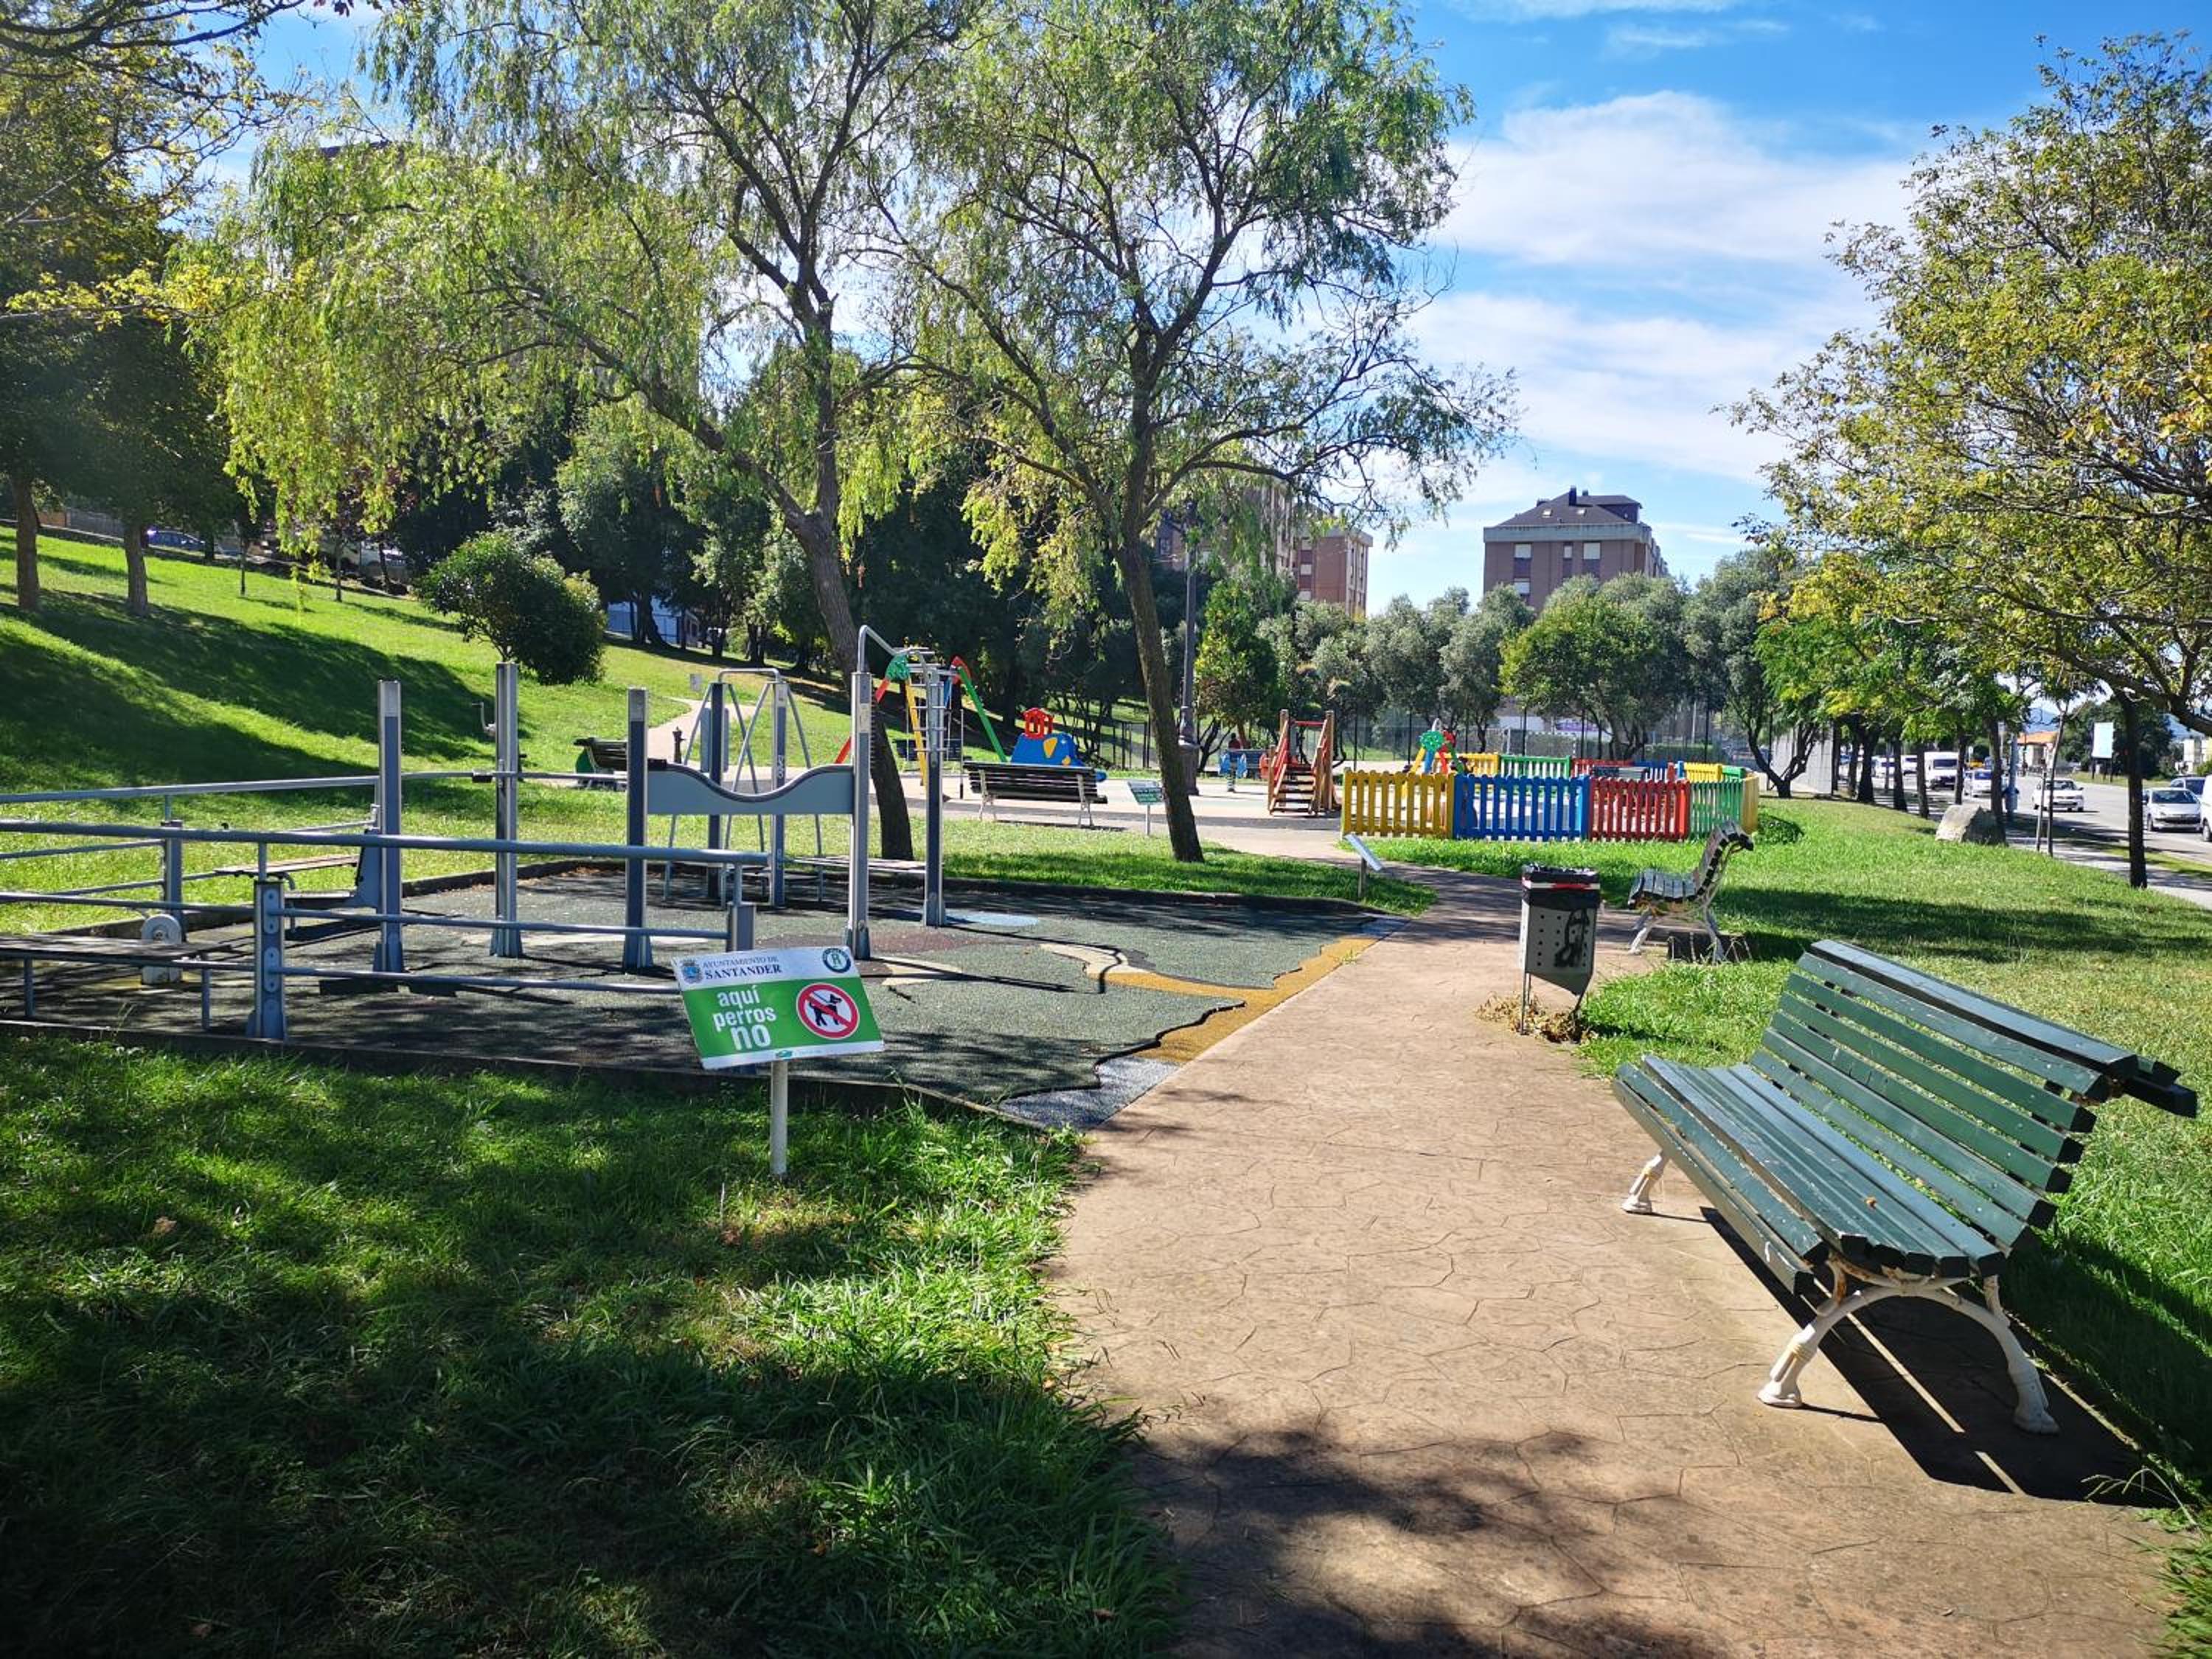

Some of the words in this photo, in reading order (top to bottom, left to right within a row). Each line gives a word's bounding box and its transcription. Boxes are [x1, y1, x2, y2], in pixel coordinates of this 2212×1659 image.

[705, 964, 782, 980] SANTANDER
[717, 984, 760, 1009] aquí
[713, 1006, 776, 1032] perros
[731, 1024, 771, 1051] no
